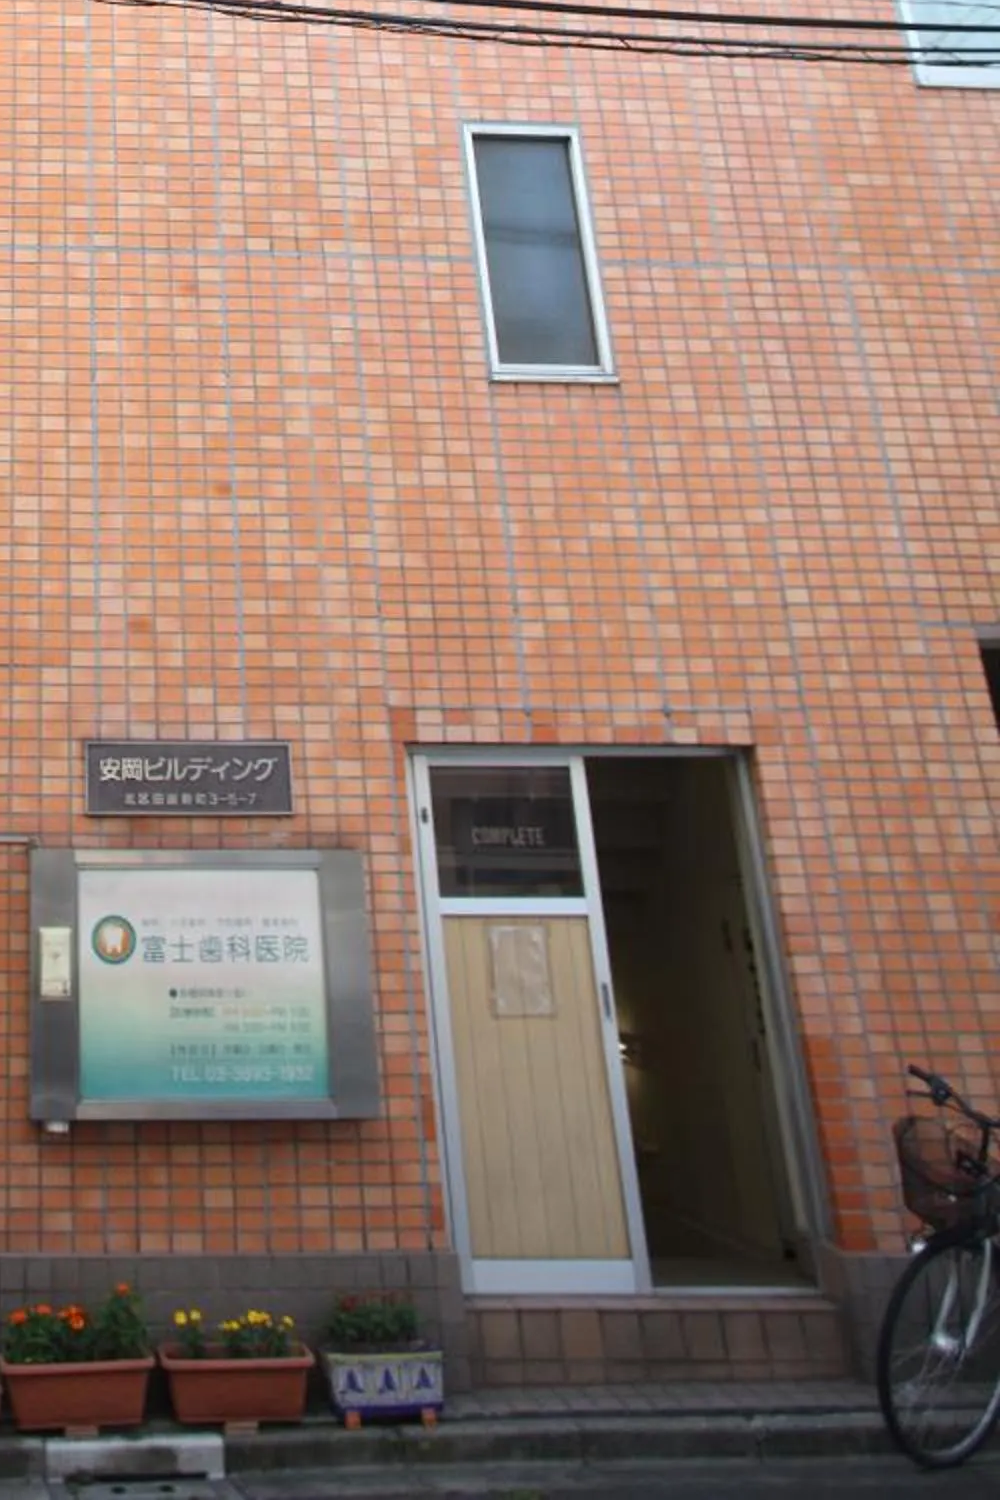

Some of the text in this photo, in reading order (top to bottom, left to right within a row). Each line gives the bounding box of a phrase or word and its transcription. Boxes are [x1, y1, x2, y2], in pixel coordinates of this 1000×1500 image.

[99, 756, 279, 782] 安岡ビルディング
[141, 935, 310, 964] 富士歯科医院
